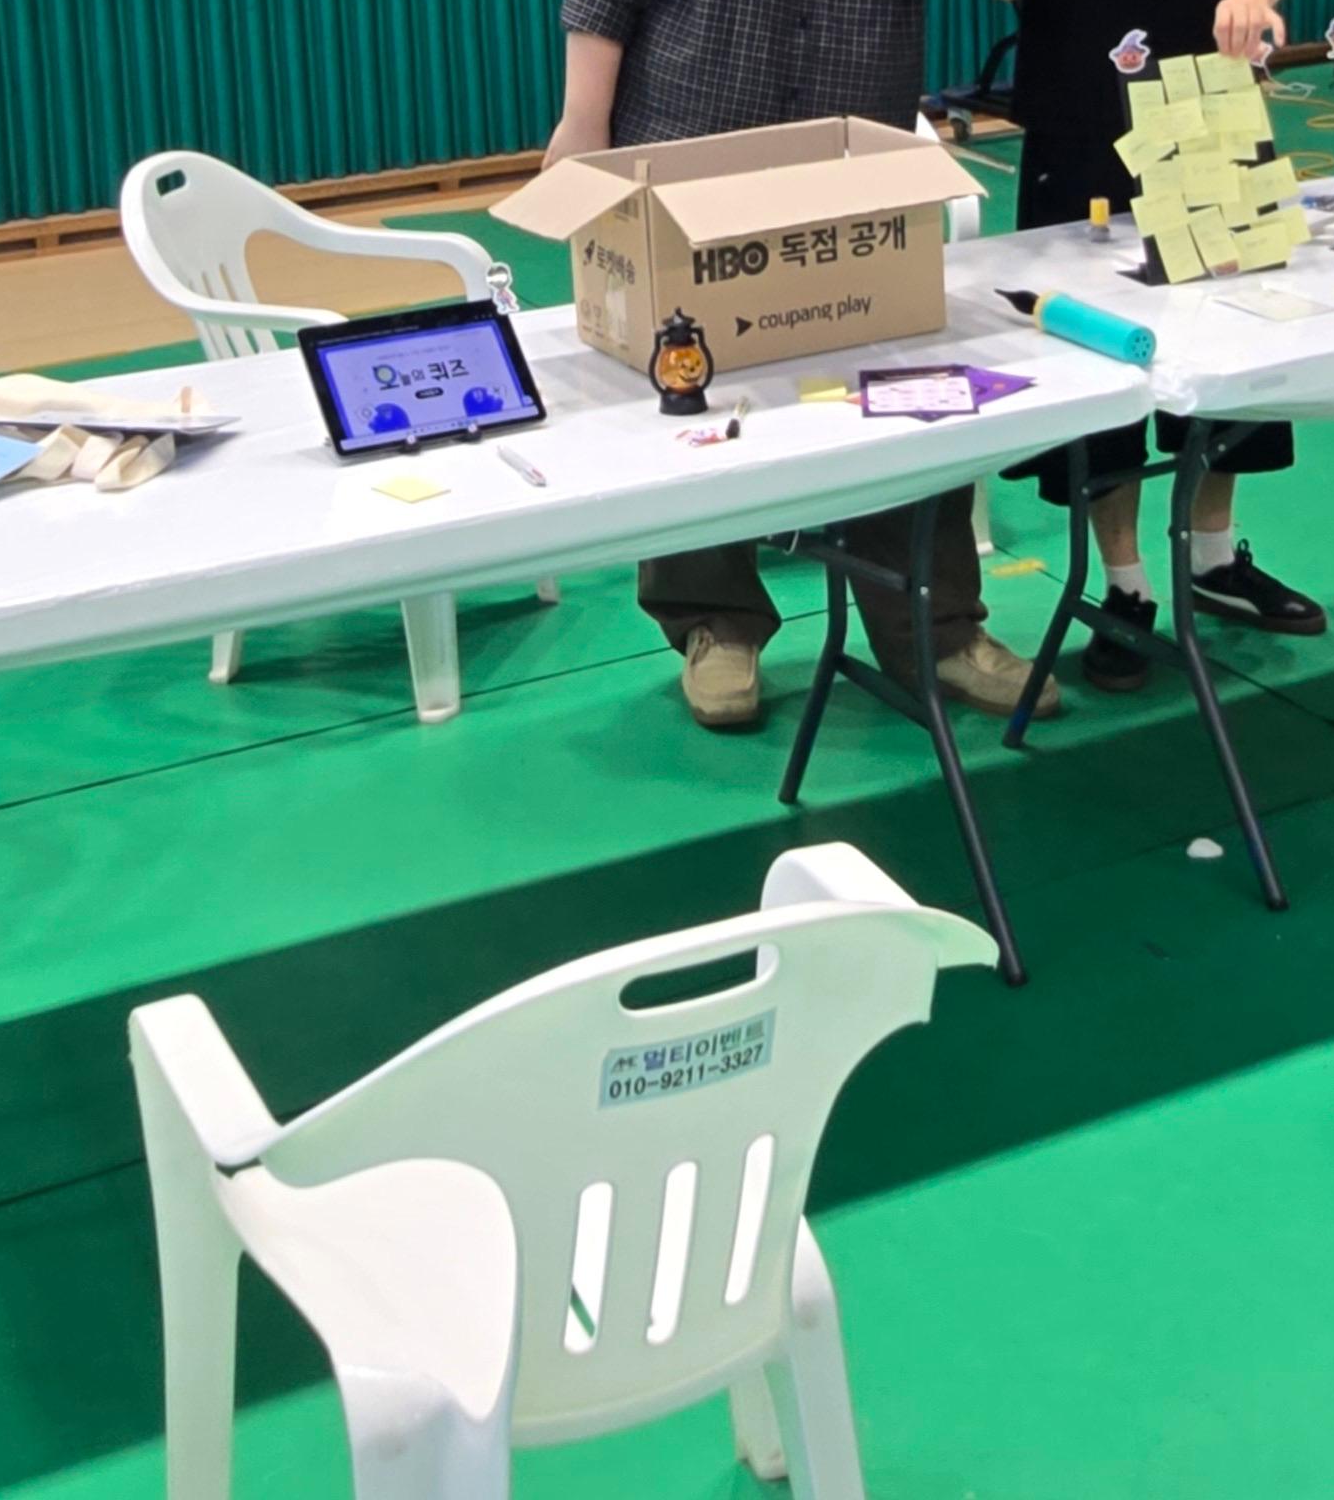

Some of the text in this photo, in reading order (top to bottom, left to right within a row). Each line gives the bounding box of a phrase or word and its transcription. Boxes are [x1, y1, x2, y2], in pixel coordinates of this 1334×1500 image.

[692, 214, 906, 286] HBO 독점 공개
[758, 295, 871, 329] coupang play
[427, 358, 470, 382] 퀴즈
[608, 1043, 765, 1100] 010-9211-3327
